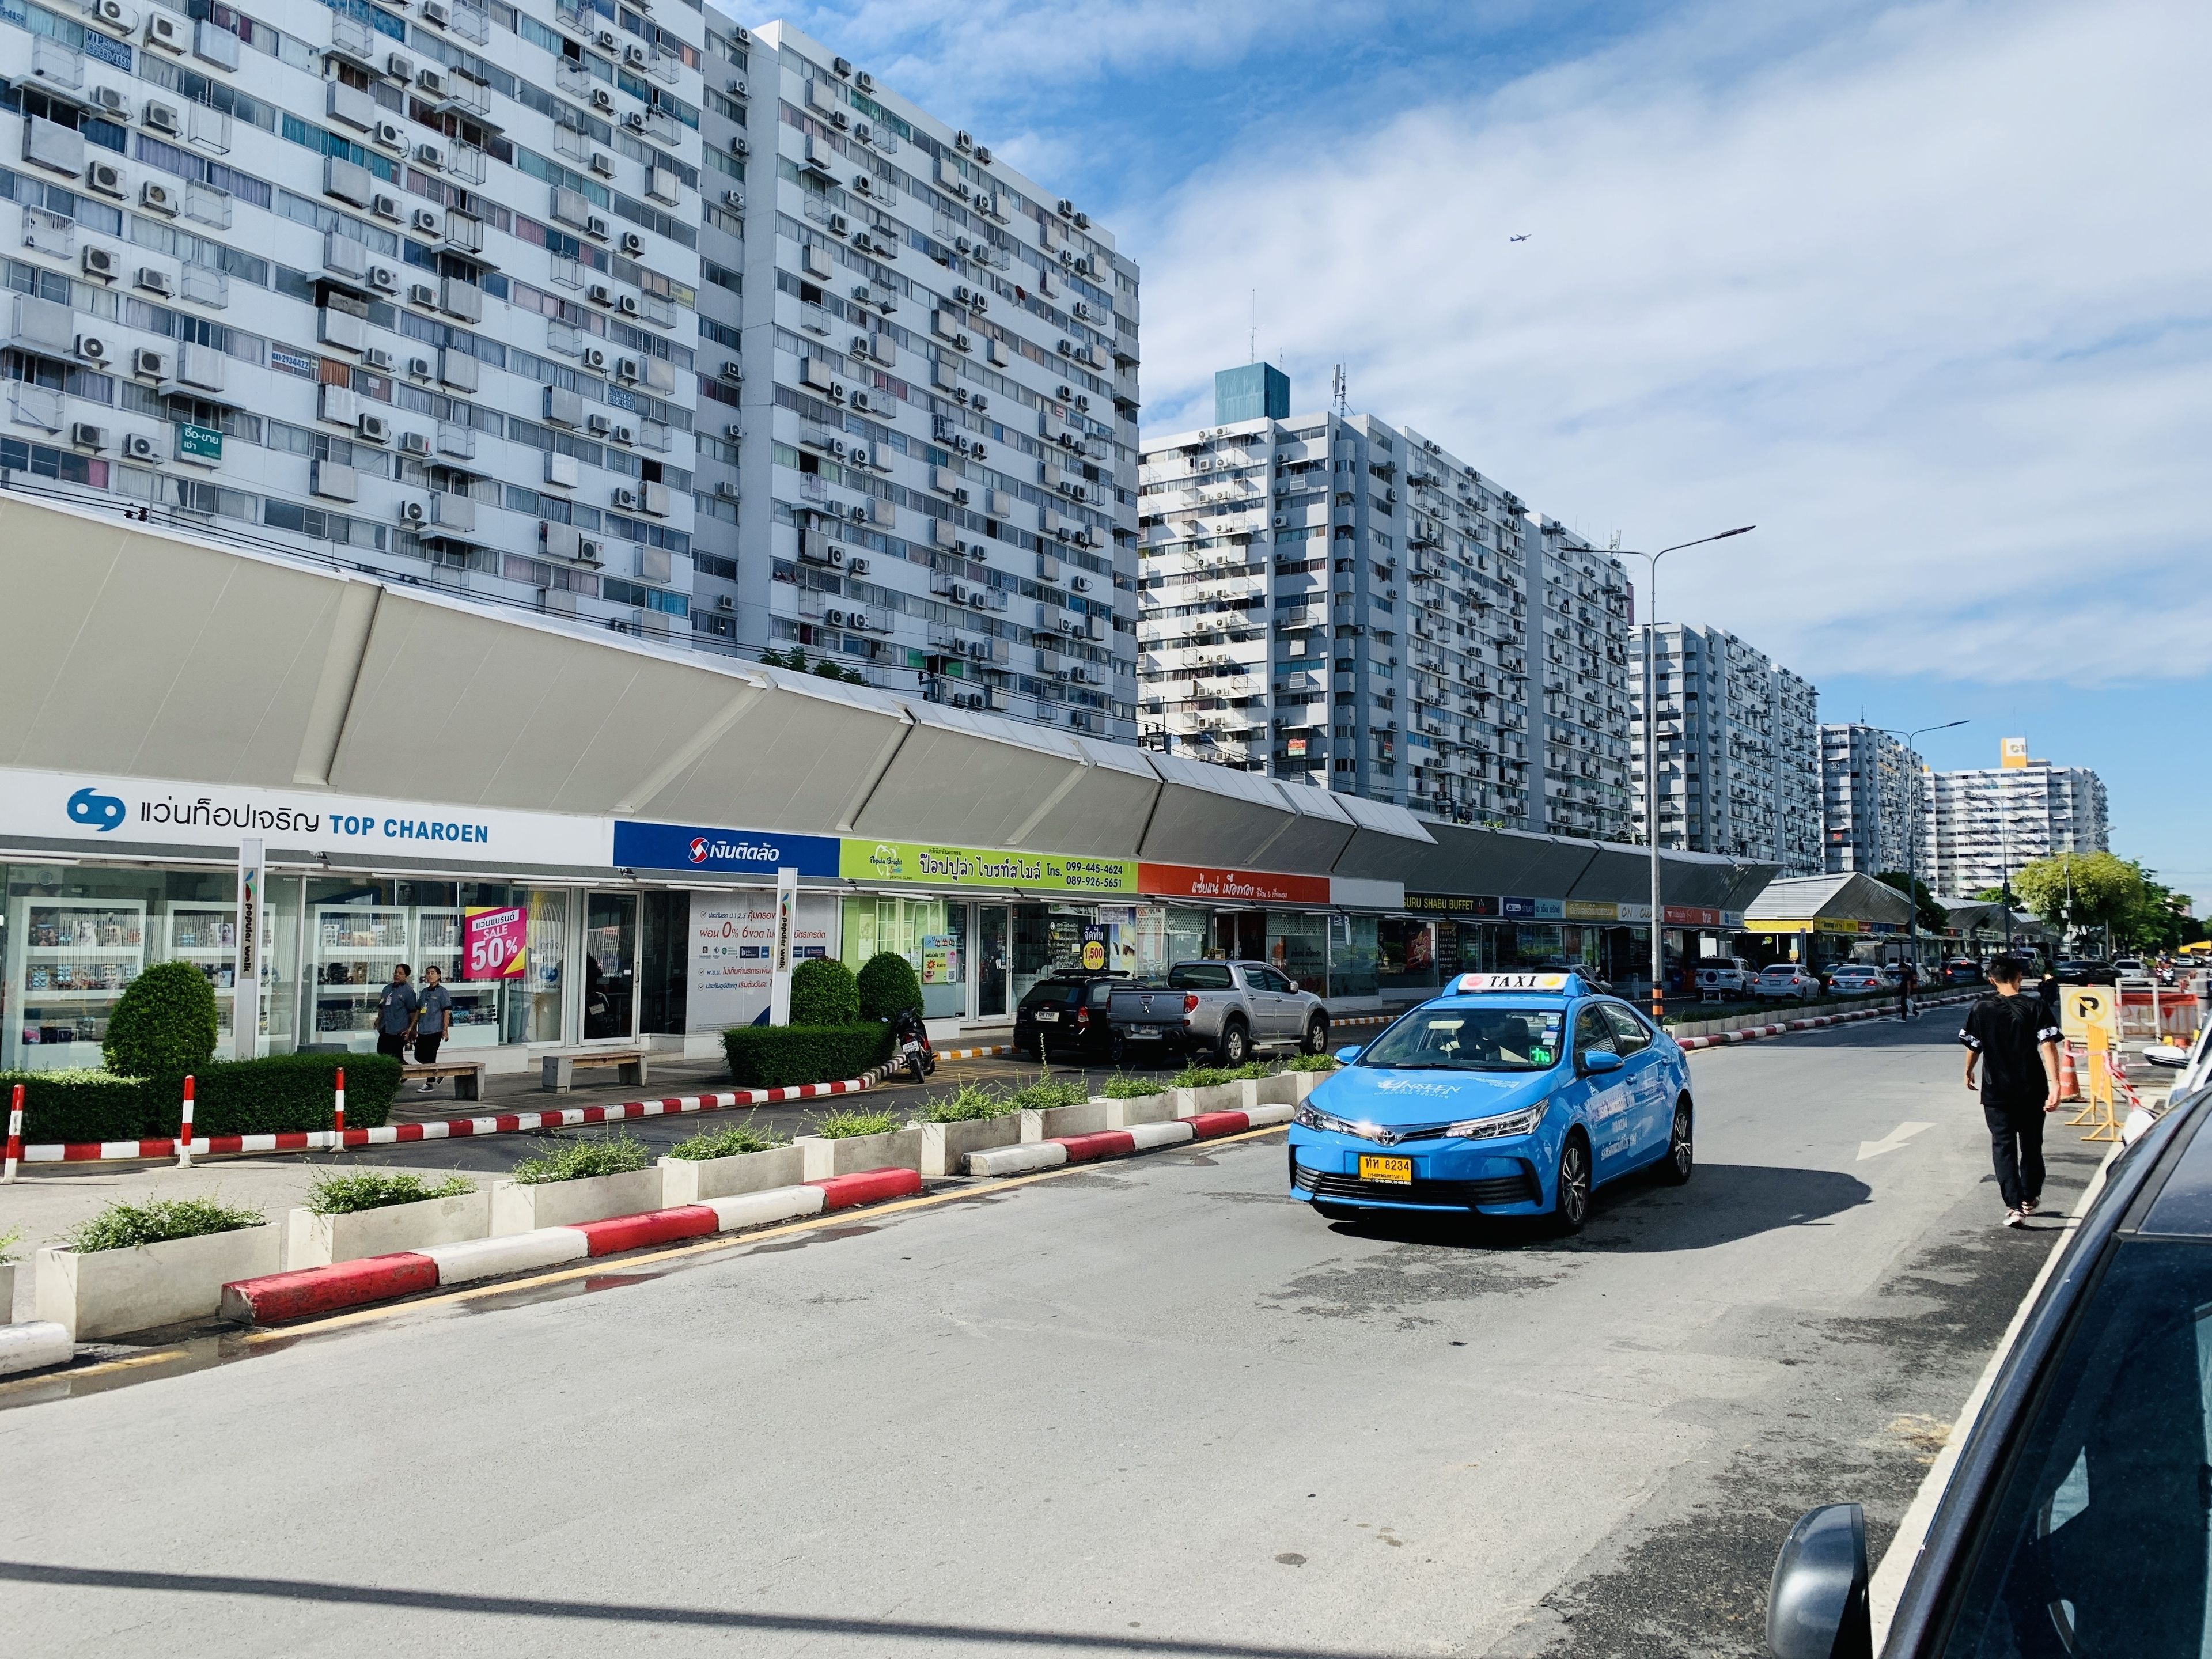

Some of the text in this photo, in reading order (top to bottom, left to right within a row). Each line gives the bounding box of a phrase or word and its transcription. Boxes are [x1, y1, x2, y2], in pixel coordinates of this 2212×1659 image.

[184, 426, 218, 445] ซื้อ-ขาย
[184, 440, 196, 450] เช่า
[141, 796, 488, 843] แว่นท็อปเจริญ TOP CHAROEN
[709, 840, 780, 862] เงินติดล้อ
[887, 857, 902, 867] Bright
[920, 853, 1123, 881] ป๊อปปูล่า ไบรท์สไมล์ โทร. 099-445-4624
[1066, 875, 1122, 888] 089-926-5651
[1222, 873, 1254, 896] เมืองทอง
[1424, 898, 1447, 909] SHABU
[1449, 899, 1474, 910] BUFFET
[476, 911, 515, 929] แว่นแบรนด์
[243, 903, 253, 972] popular walk
[483, 924, 508, 941] SALE
[700, 927, 719, 938] ผ่อน
[1084, 926, 1103, 941] จัดฟัน
[1084, 946, 1103, 961] 1,500
[1489, 976, 1537, 987] TAXI
[2079, 997, 2099, 1017] P
[1385, 1160, 1409, 1171] 8234
